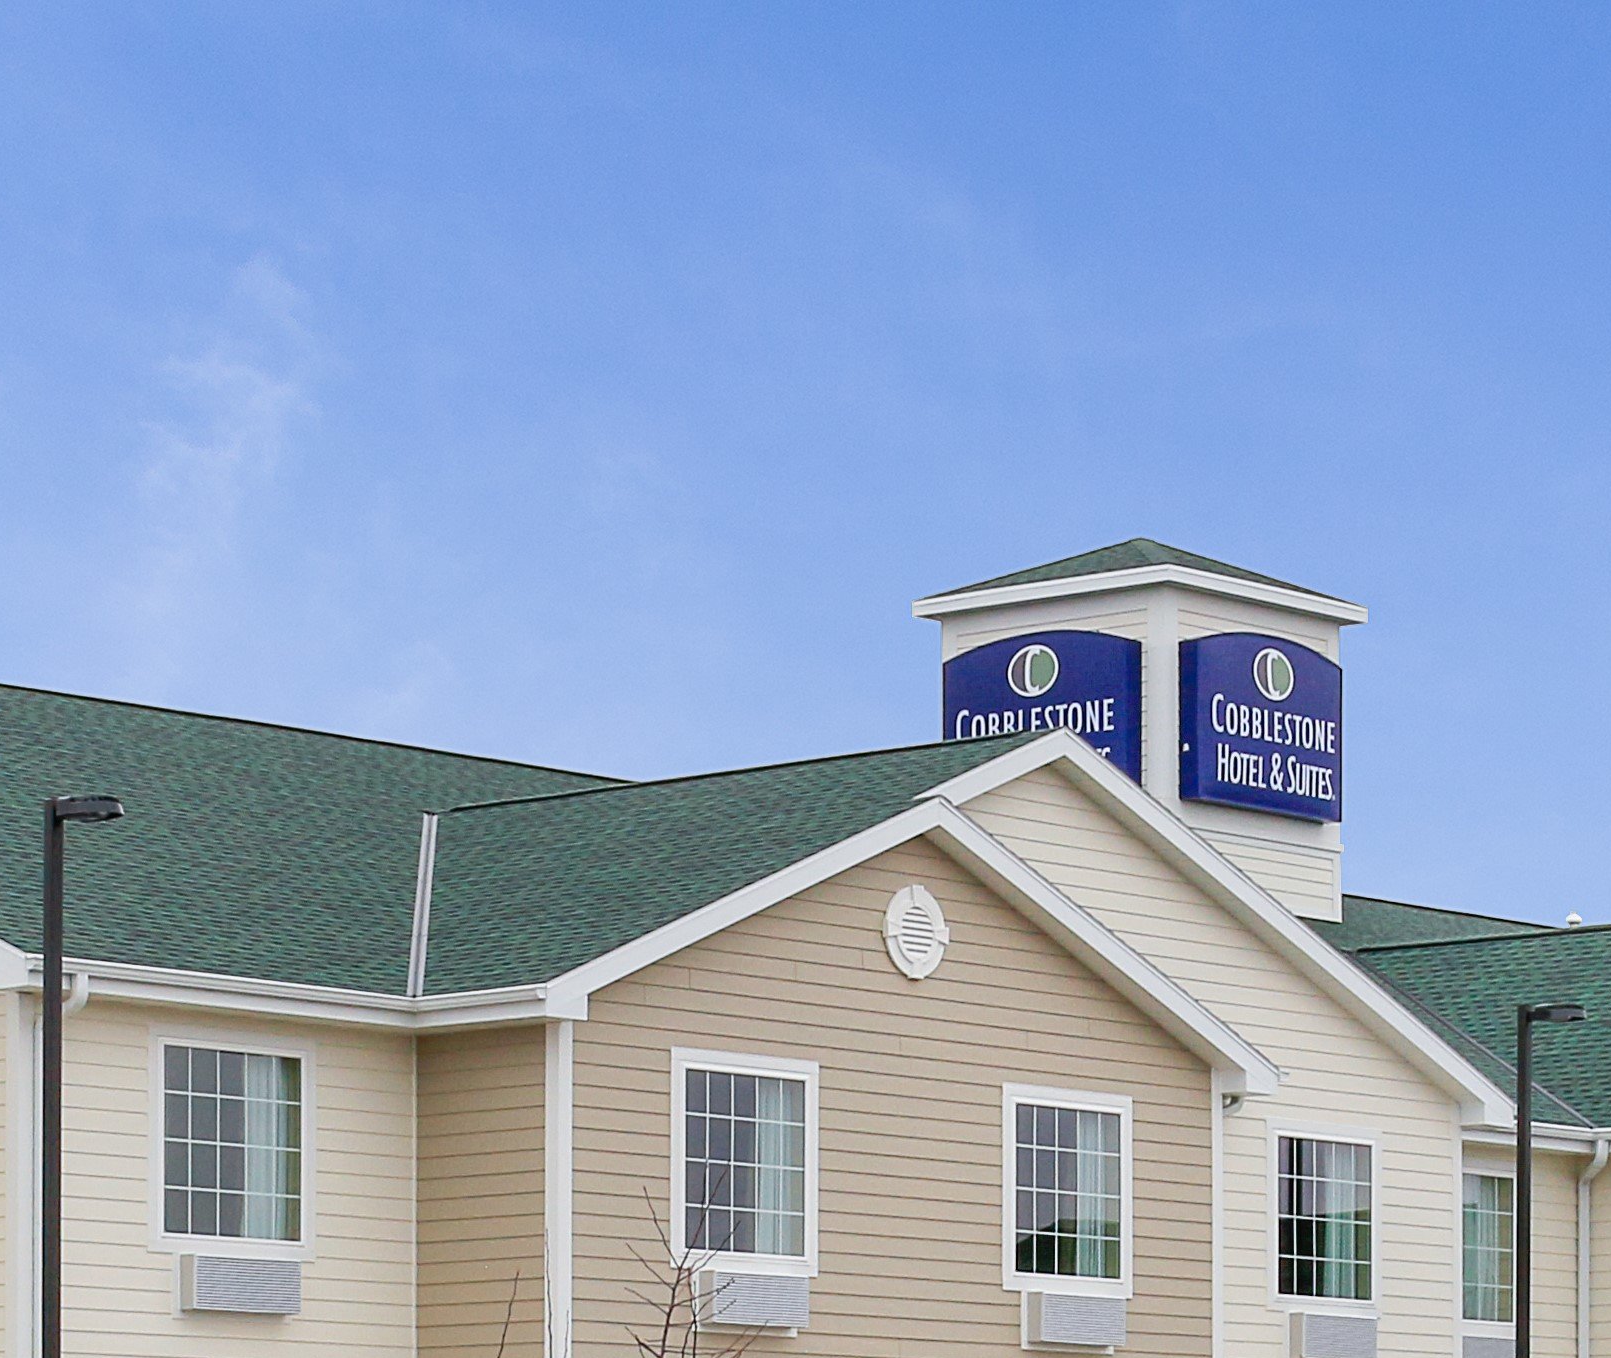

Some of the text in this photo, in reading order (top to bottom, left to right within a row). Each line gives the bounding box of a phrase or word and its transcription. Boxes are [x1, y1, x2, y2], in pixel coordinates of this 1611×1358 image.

[1211, 693, 1336, 754] COBBLESTONE
[1217, 742, 1267, 789] HOTEL
[1269, 752, 1284, 792] &
